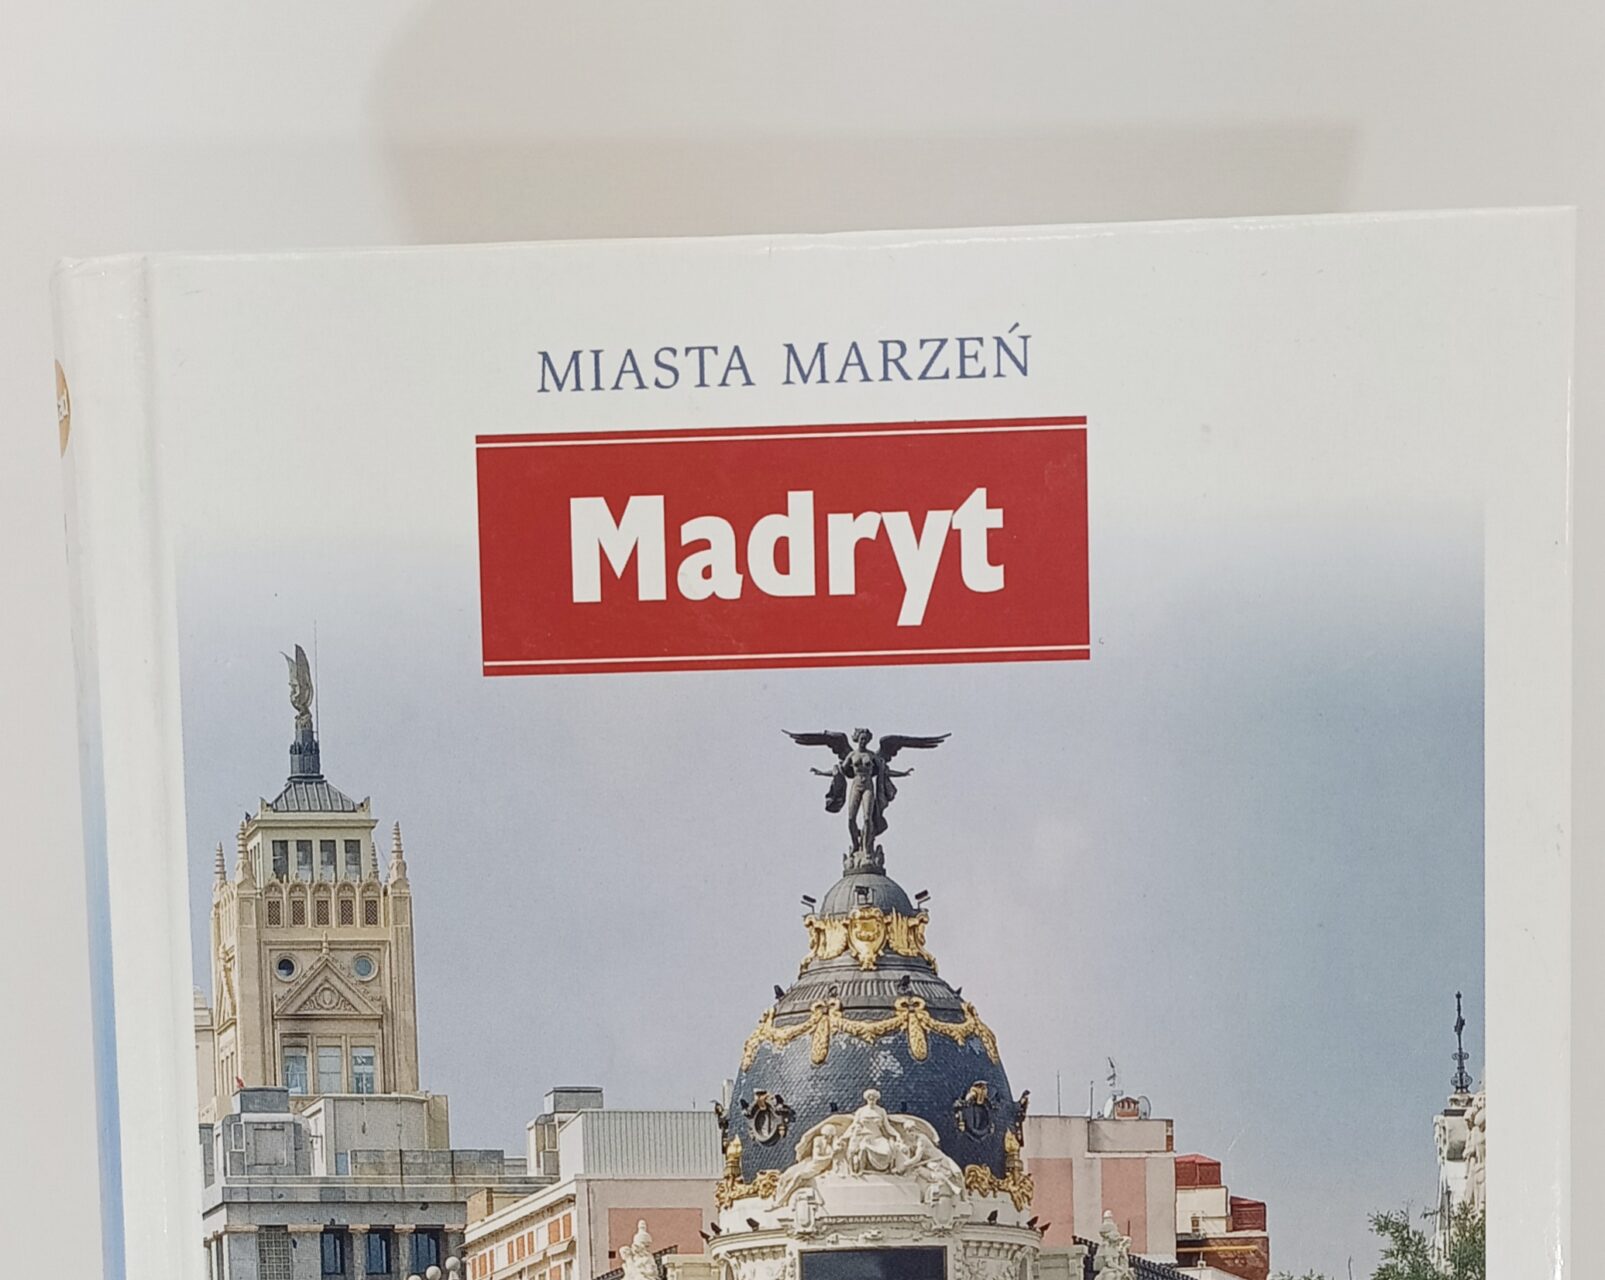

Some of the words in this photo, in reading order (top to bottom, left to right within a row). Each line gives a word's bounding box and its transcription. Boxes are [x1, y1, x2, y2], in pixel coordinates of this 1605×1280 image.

[537, 344, 756, 393] MIASTA
[782, 322, 1032, 385] MARZEŃ
[569, 487, 1005, 627] Madryt
